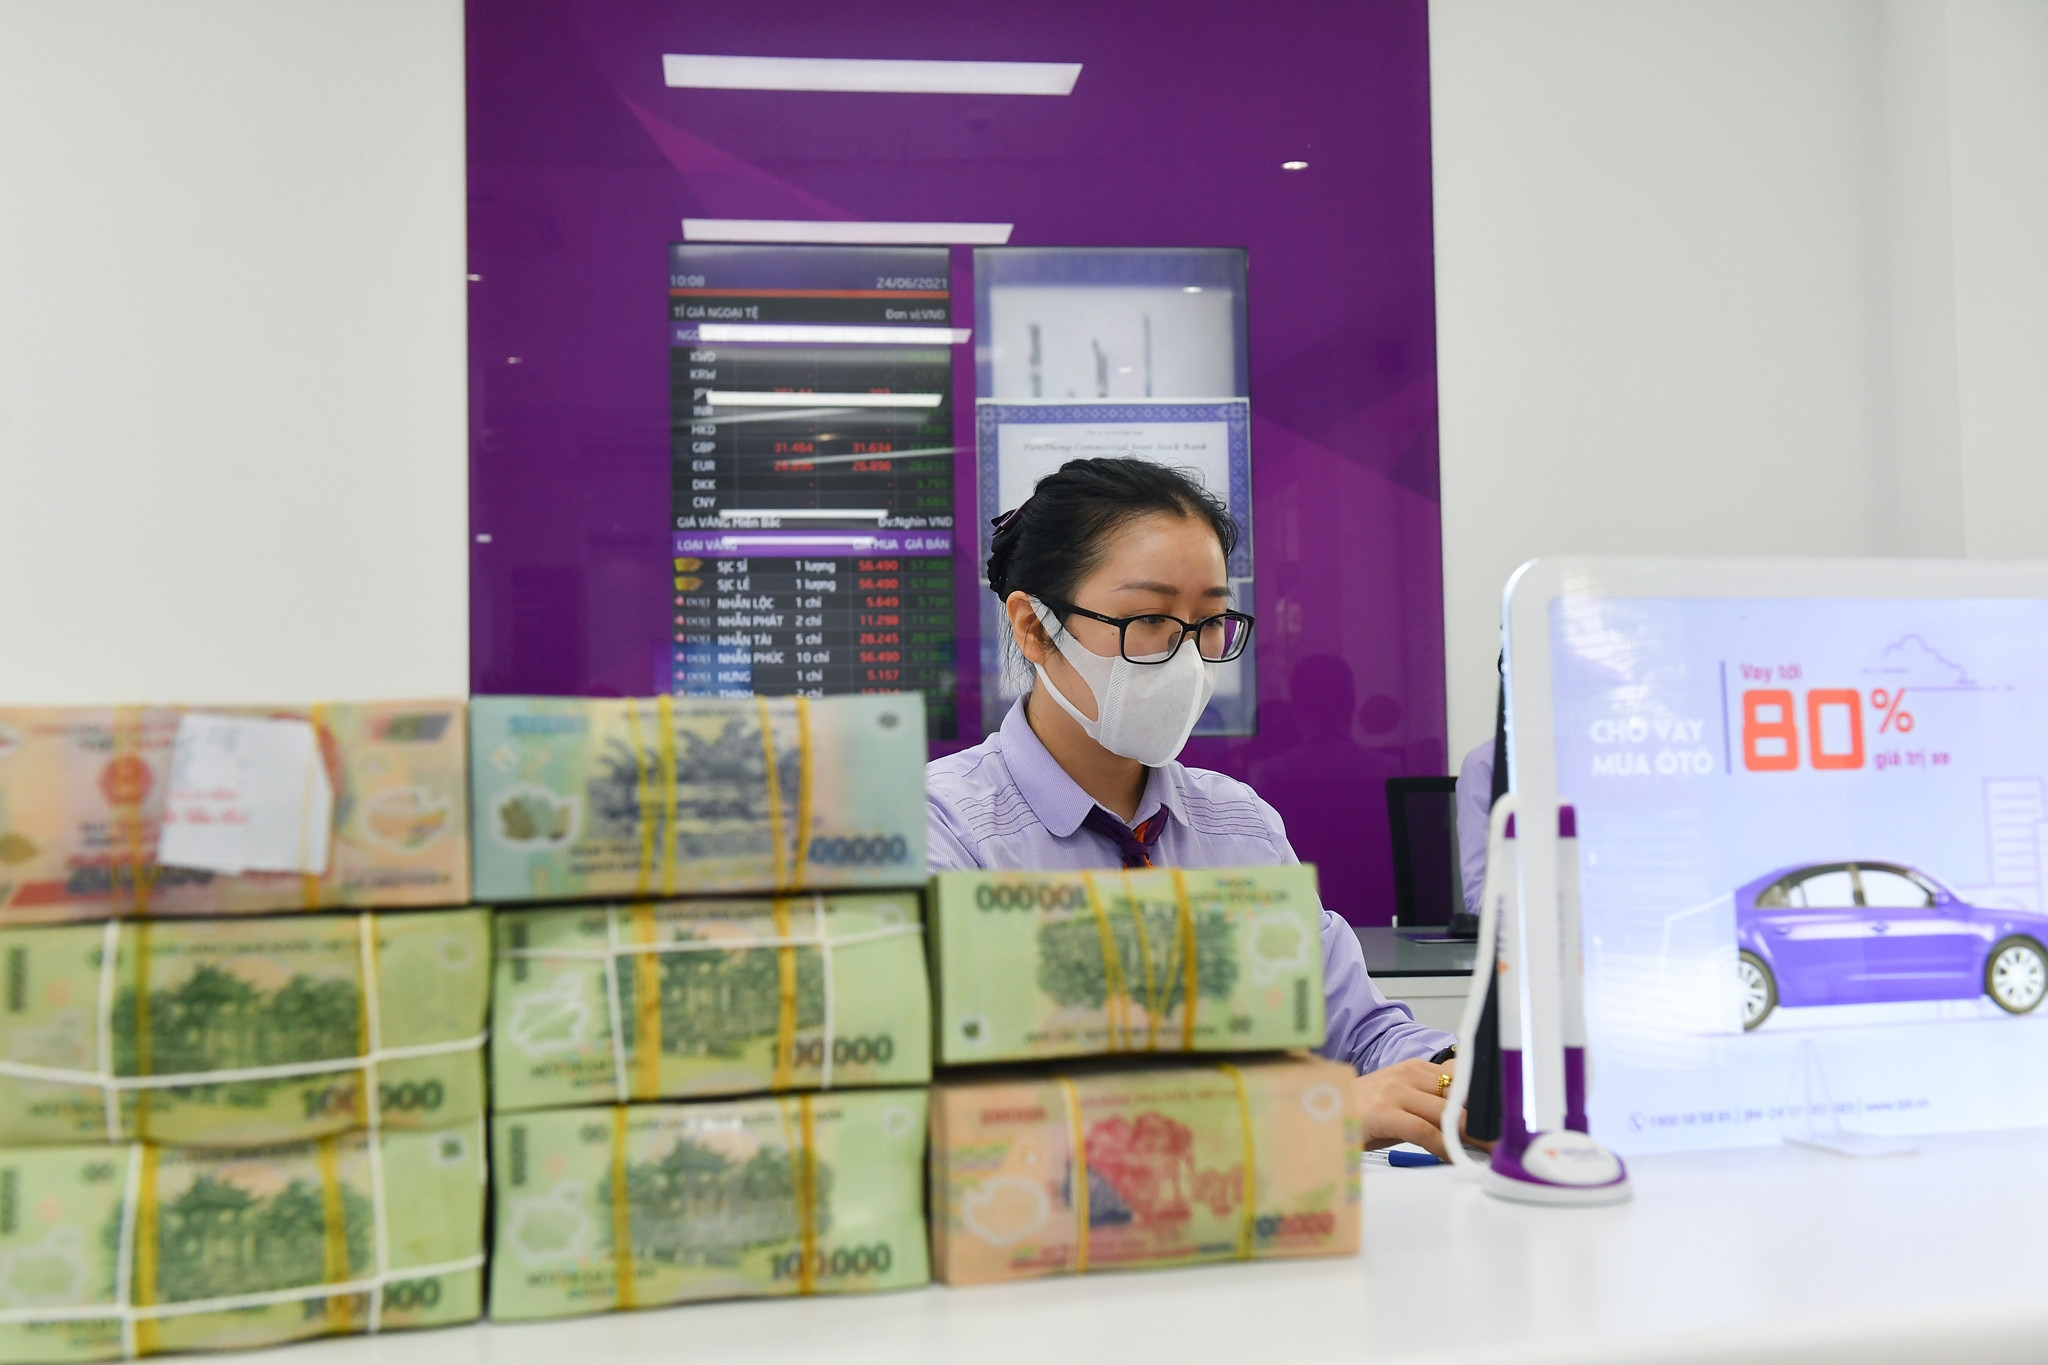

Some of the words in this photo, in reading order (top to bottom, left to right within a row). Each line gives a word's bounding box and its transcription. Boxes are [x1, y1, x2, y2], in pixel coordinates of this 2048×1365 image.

[670, 275, 705, 287] 10:08
[876, 277, 947, 289] 24/06/2021
[692, 442, 716, 453] GBP
[692, 460, 716, 472] EUR
[692, 497, 716, 508] CNY
[677, 515, 697, 528] GIÁ
[796, 615, 804, 627] 2
[796, 633, 804, 645] 5
[797, 652, 811, 663] 10
[867, 669, 900, 681] 5.157
[1740, 663, 1773, 683] Vay
[1590, 719, 1648, 743] CHO
[1653, 719, 1704, 742] VAY
[1592, 752, 1649, 776] MUA
[1655, 746, 1714, 775] ÔTÔ
[1874, 751, 1900, 770] giá
[1932, 752, 1952, 766] xe
